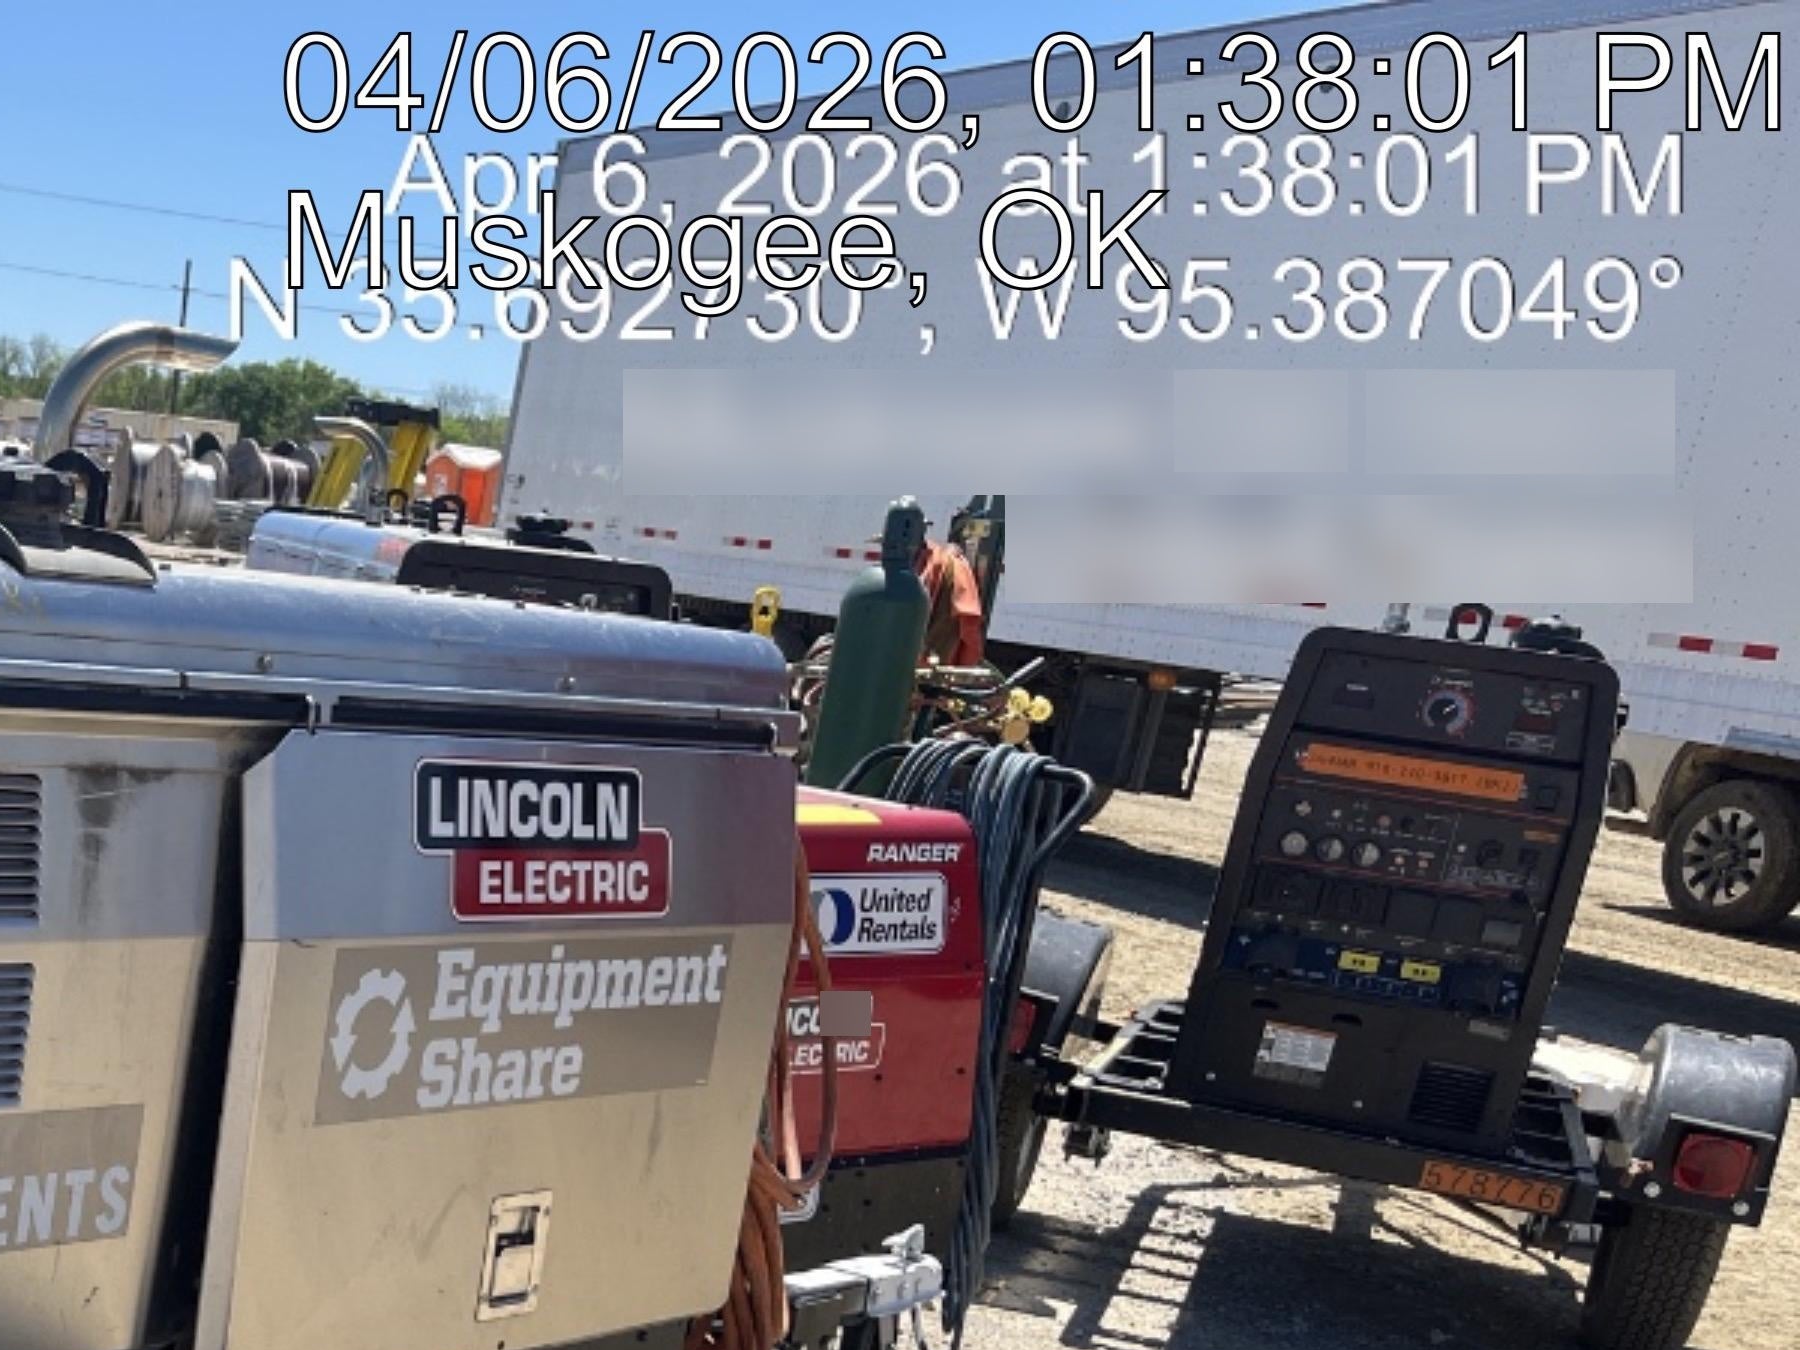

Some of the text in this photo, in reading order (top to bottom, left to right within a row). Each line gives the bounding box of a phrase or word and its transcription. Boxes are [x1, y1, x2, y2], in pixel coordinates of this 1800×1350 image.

[428, 777, 630, 841] LINCOLN
[866, 843, 963, 863] RANGER
[479, 860, 650, 905] ELECTRIC
[859, 887, 935, 913] United
[857, 914, 937, 943] Rentals
[428, 942, 728, 1032] Equipment
[788, 1041, 871, 1067] ECRIC
[415, 1040, 584, 1109] Share
